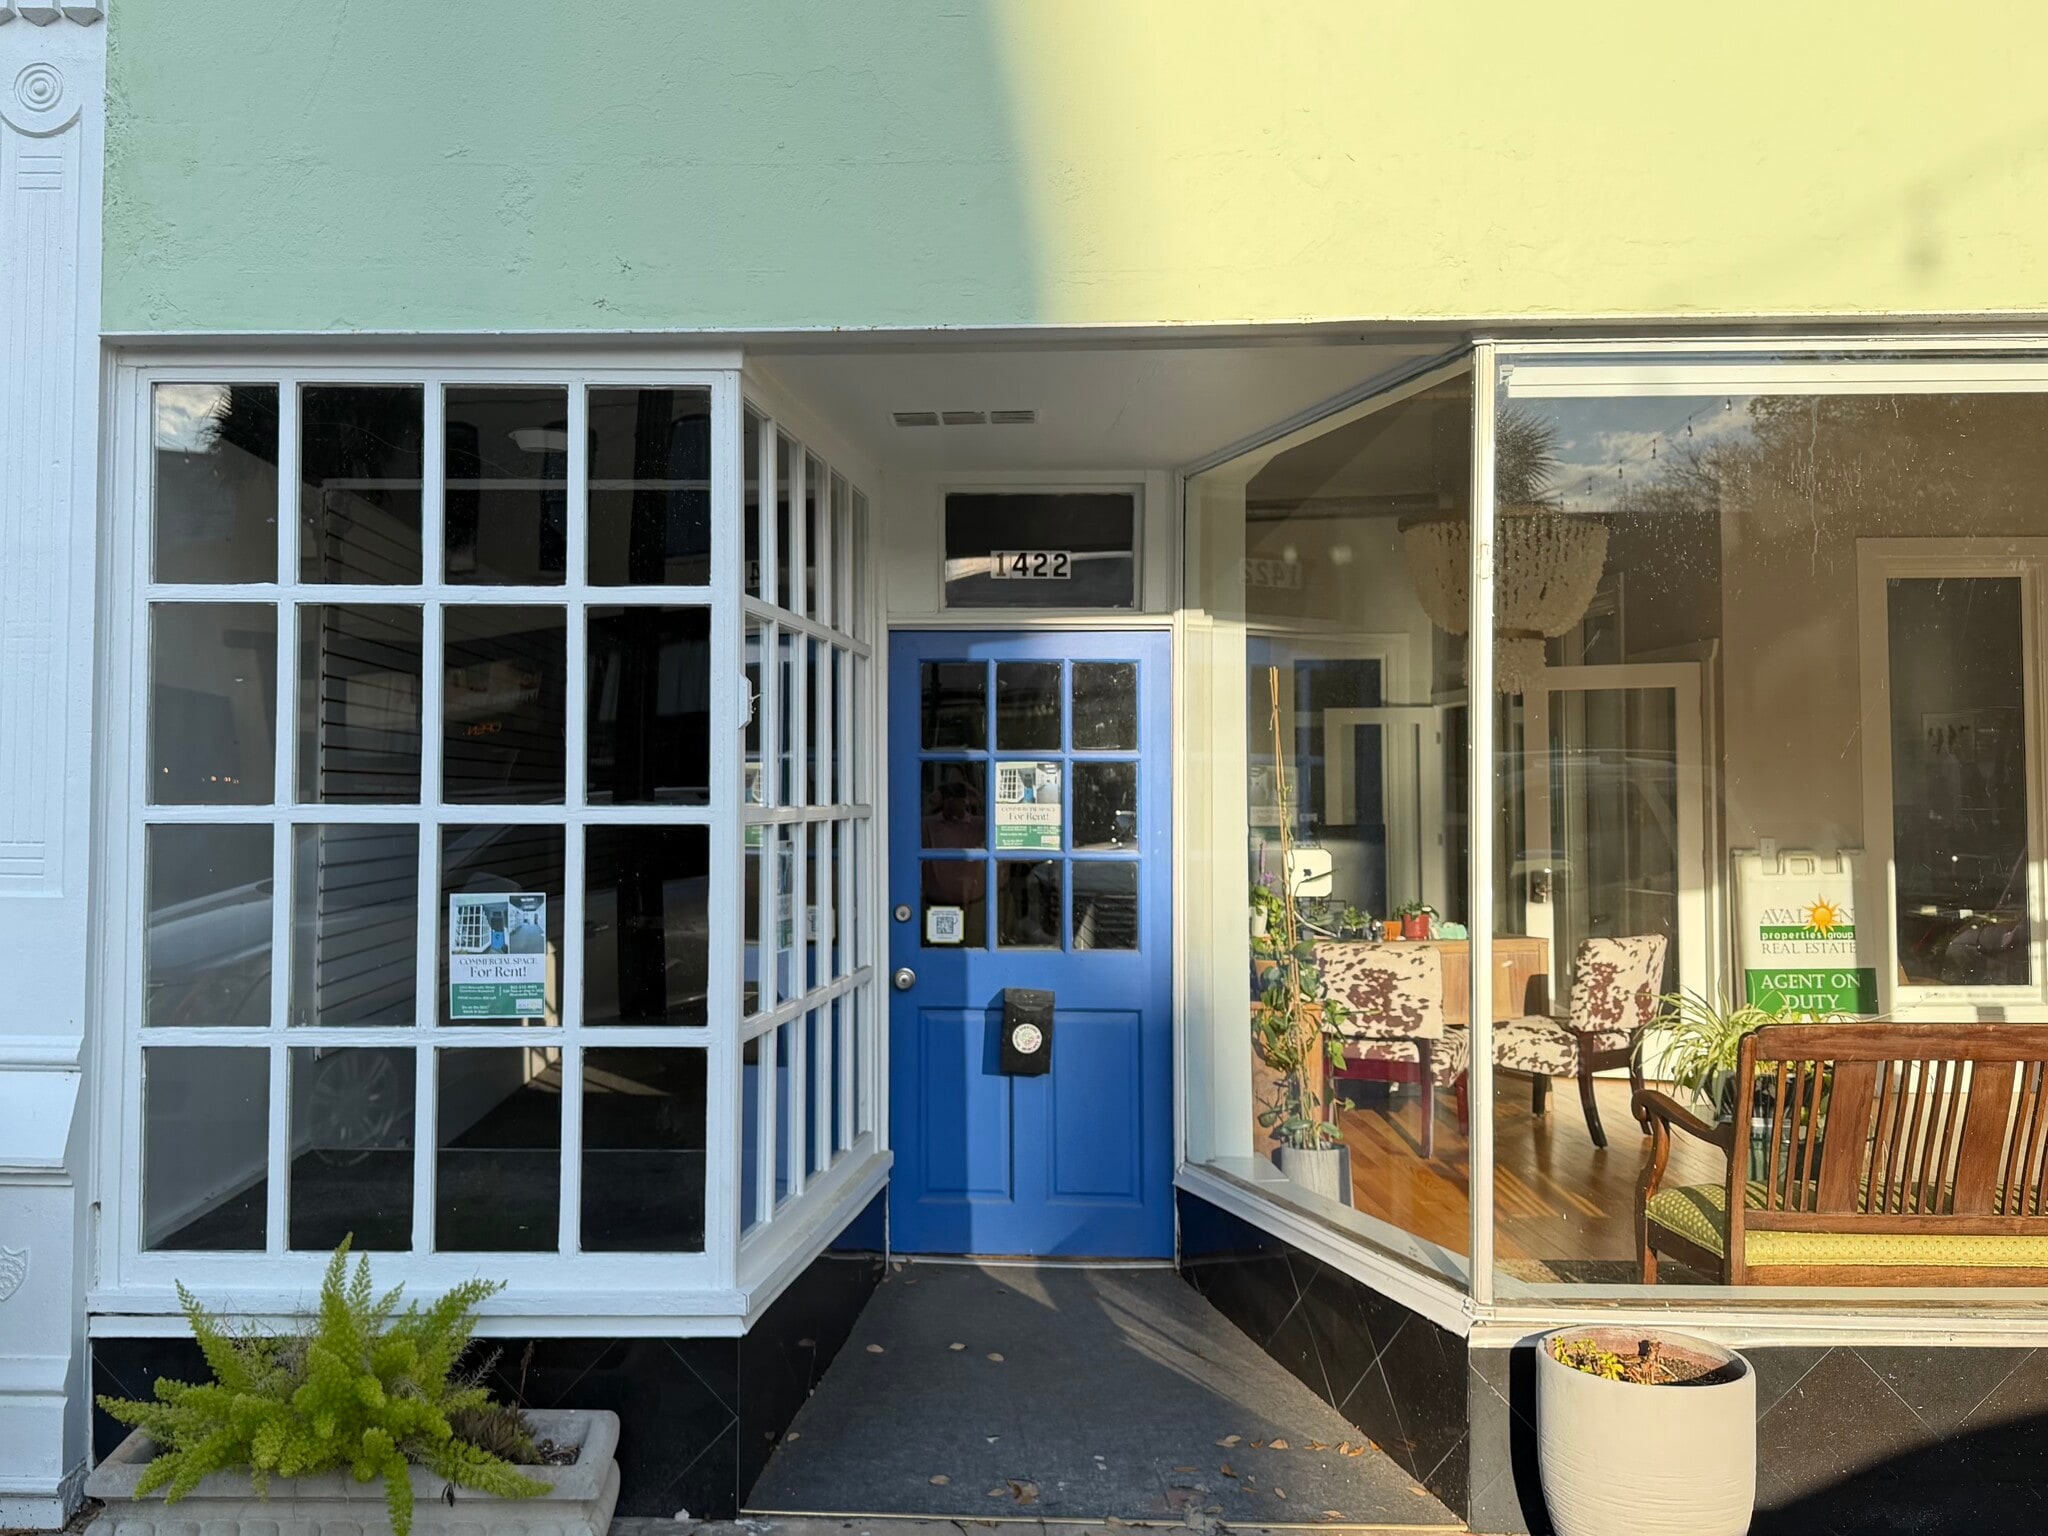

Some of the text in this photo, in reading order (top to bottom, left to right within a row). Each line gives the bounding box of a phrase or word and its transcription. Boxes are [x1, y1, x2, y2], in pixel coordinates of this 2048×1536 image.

[996, 552, 1068, 577] 1422
[1760, 908, 1854, 924] AVALN
[1761, 930, 1854, 940] properties group
[1762, 942, 1857, 954] REAL ESTATE
[470, 966, 527, 978] For Rent!
[1761, 973, 1861, 990] AGENT ON
[1785, 994, 1840, 1010] DUTY
